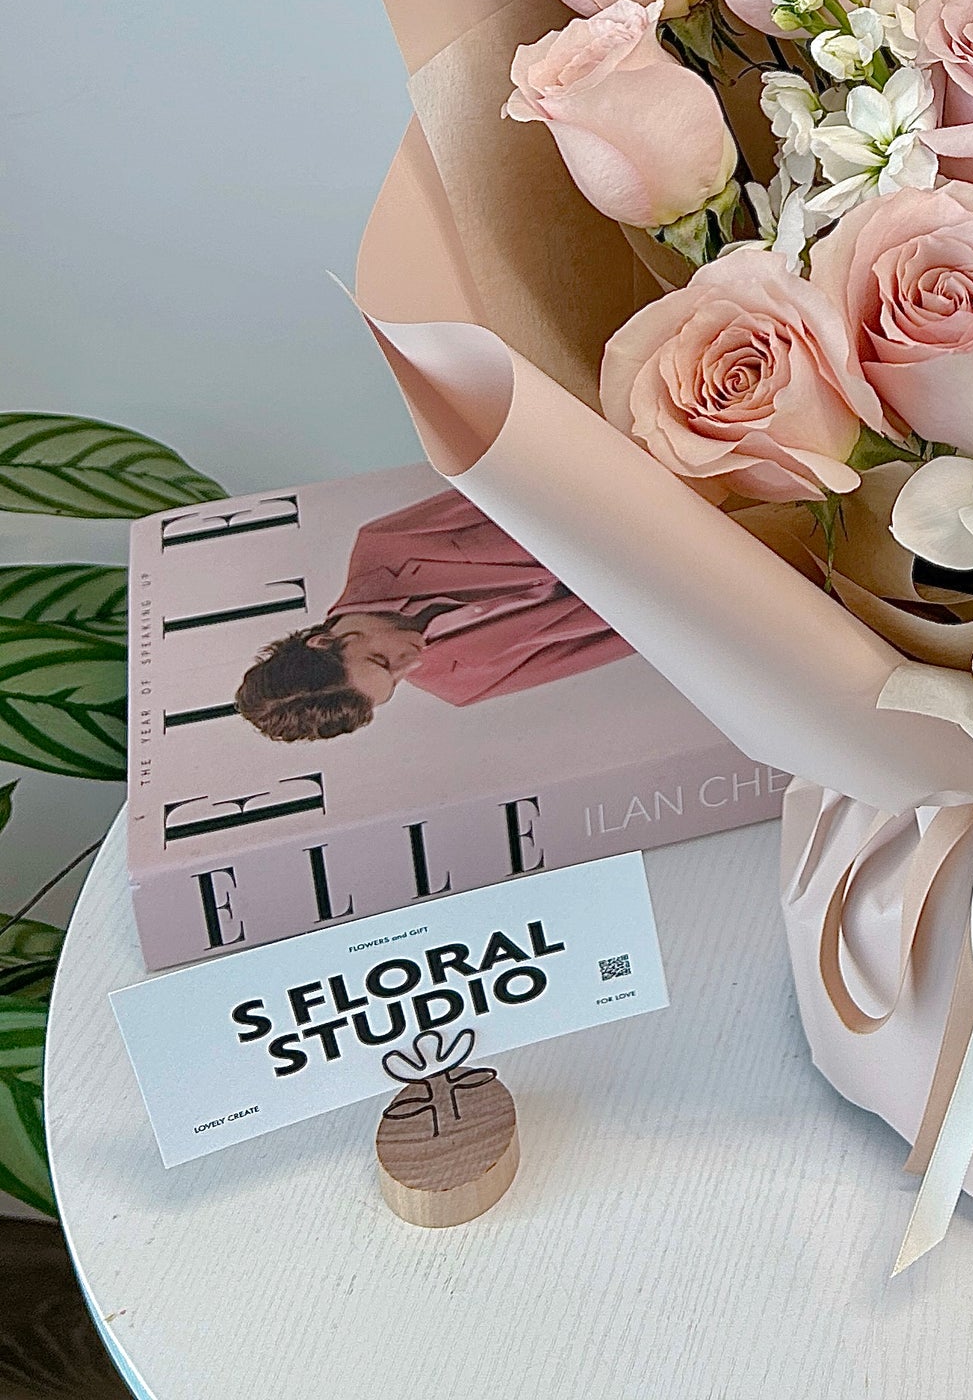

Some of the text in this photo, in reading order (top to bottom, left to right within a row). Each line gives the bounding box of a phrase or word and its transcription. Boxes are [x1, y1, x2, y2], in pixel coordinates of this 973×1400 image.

[141, 573, 152, 786] THE YEAR OF SPEAKING UP
[584, 786, 684, 837] ILAN
[190, 796, 545, 951] ELLE
[348, 926, 428, 953] FLOWERS and GIFT
[231, 920, 566, 1043] S FLORAL
[268, 966, 547, 1077] STUDIO
[615, 990, 636, 1001] LOVE
[193, 1105, 260, 1134] LOVELY CREATE
